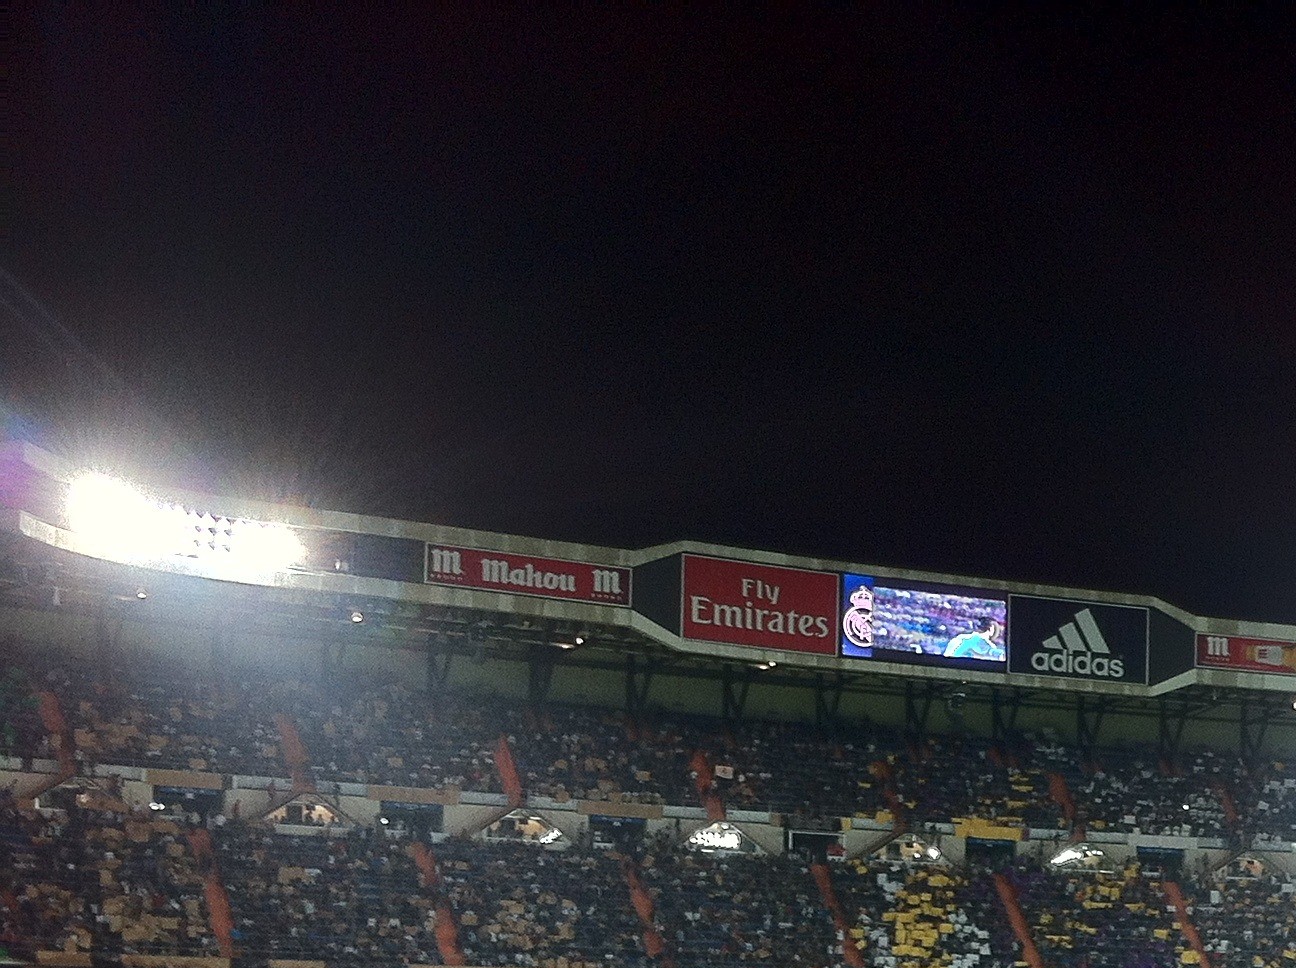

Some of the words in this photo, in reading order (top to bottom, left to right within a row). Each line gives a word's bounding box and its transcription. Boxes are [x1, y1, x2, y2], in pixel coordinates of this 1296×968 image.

[481, 558, 575, 592] Mahou
[741, 579, 780, 604] Fly
[690, 596, 829, 638] Emirates
[1031, 650, 1124, 678] adidas
